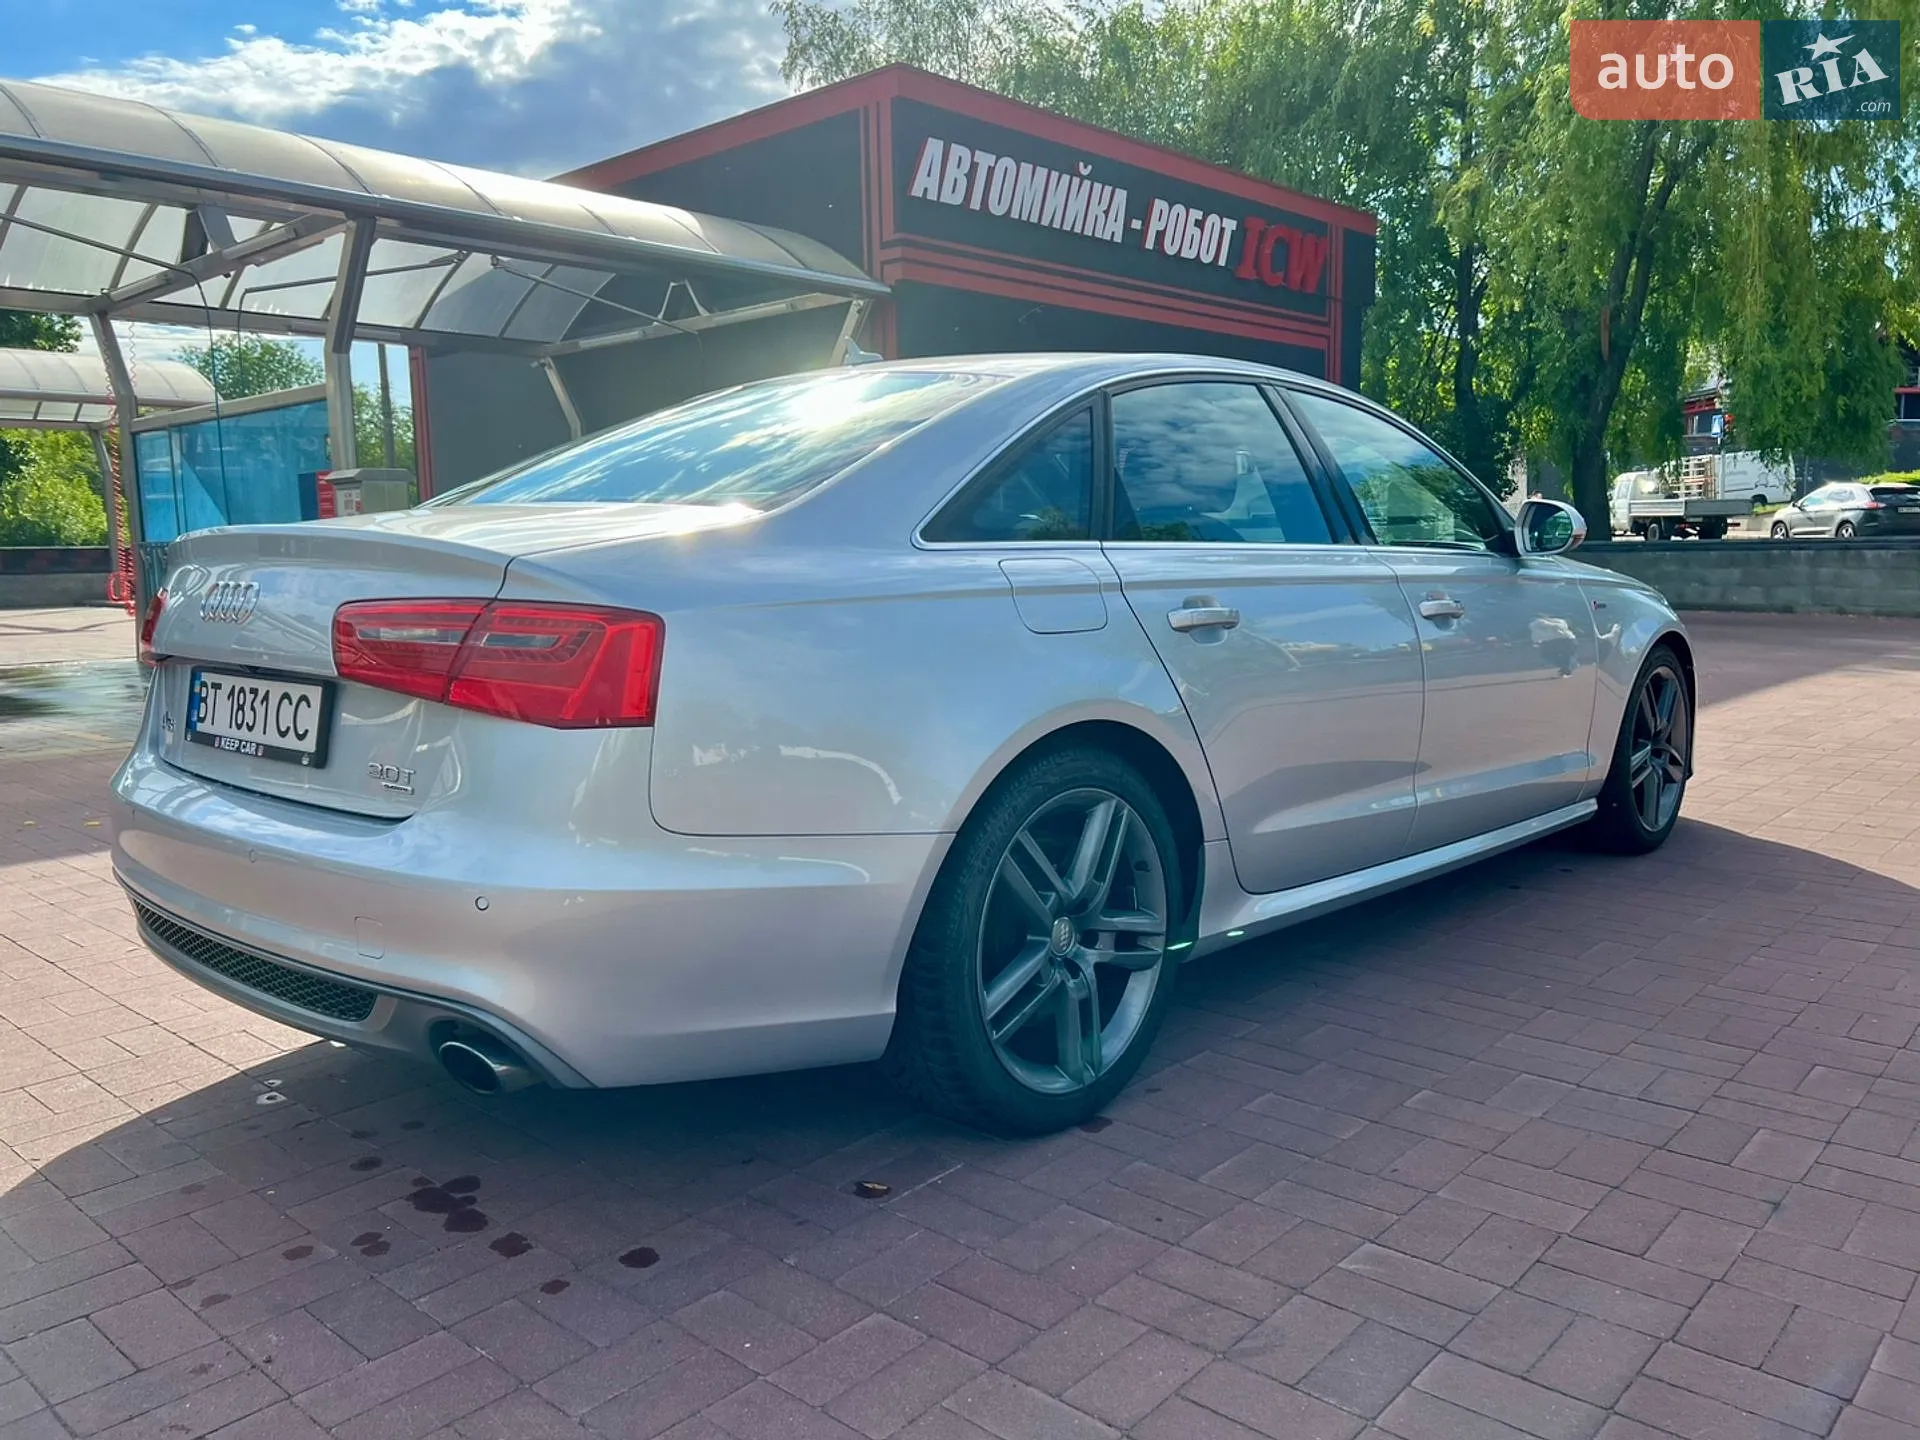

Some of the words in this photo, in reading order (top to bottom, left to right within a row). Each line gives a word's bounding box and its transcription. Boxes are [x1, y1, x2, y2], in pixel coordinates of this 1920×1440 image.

[910, 137, 1128, 243] АВТОМИЙКА
[1143, 198, 1237, 267] РОБОТ
[1236, 216, 1329, 293] ICW
[197, 680, 222, 726] BT
[227, 684, 271, 736] 1831
[275, 691, 312, 741] CC
[221, 737, 239, 754] KEEP
[240, 741, 257, 755] CAR
